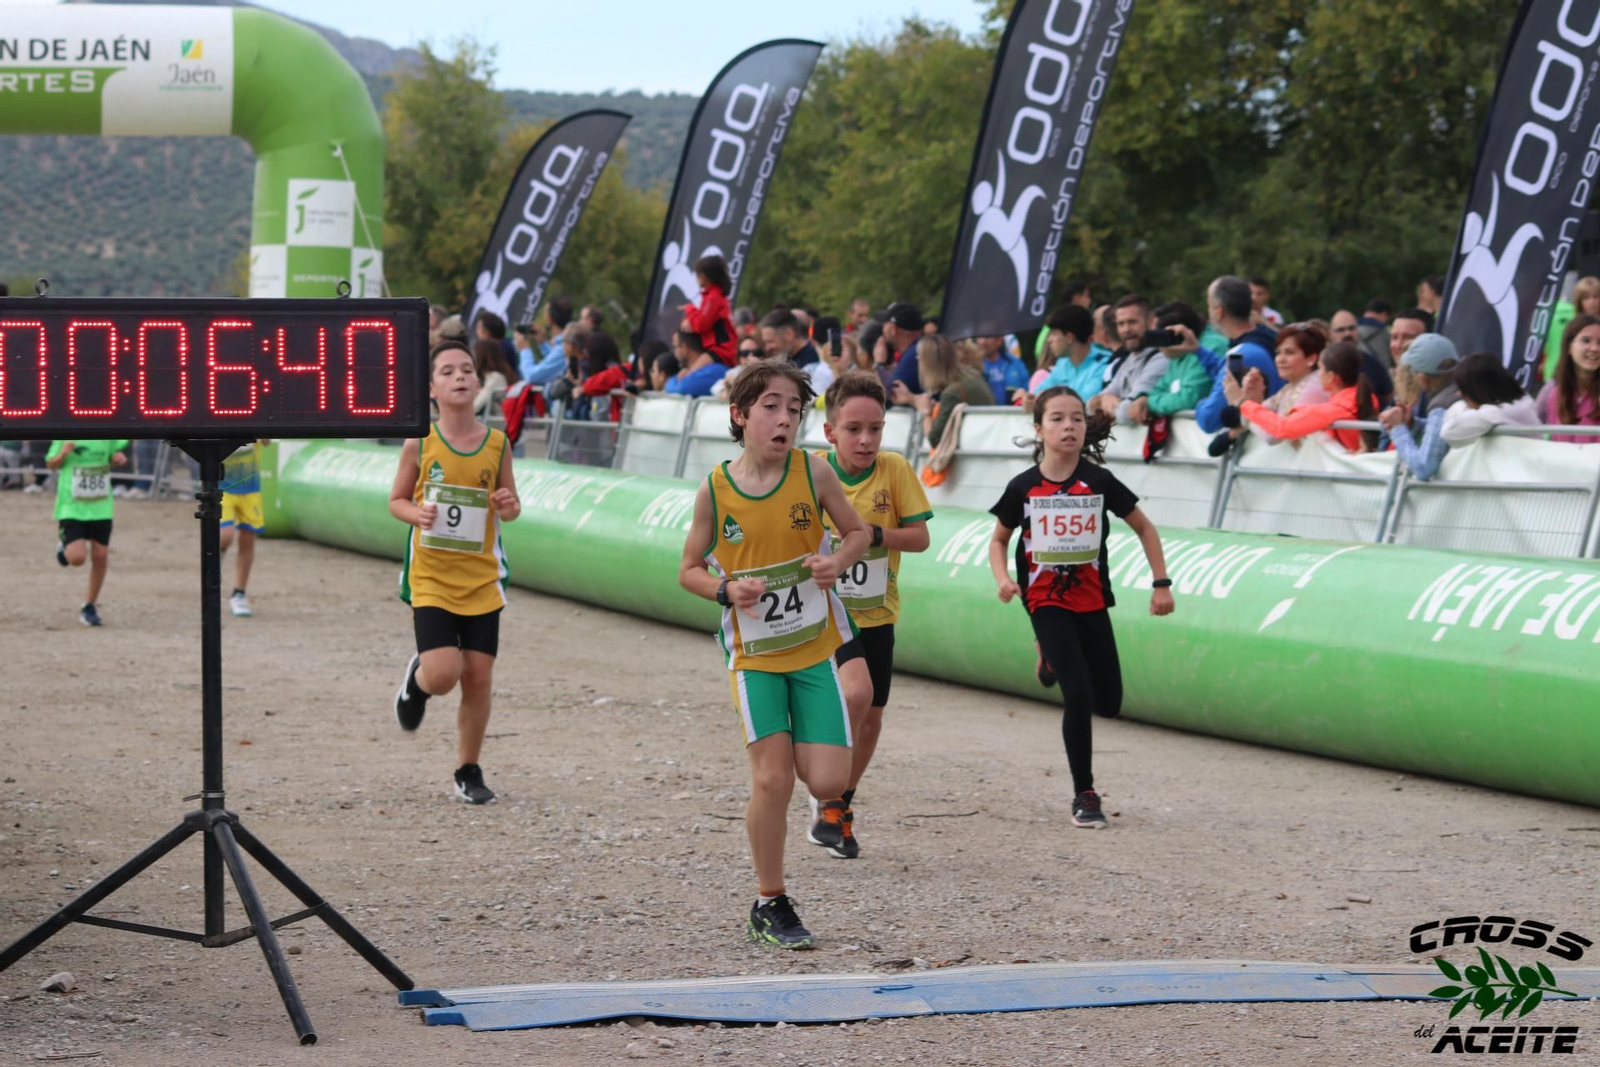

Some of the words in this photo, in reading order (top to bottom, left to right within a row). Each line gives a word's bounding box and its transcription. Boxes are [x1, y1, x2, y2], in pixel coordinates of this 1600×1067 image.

[28, 39, 67, 61] DE
[75, 34, 150, 61] JAÉN
[167, 63, 216, 85] Jaén
[446, 505, 462, 528] 9
[1039, 514, 1097, 536] 1554
[760, 585, 804, 623] 24
[1407, 563, 1564, 642] JAÉN
